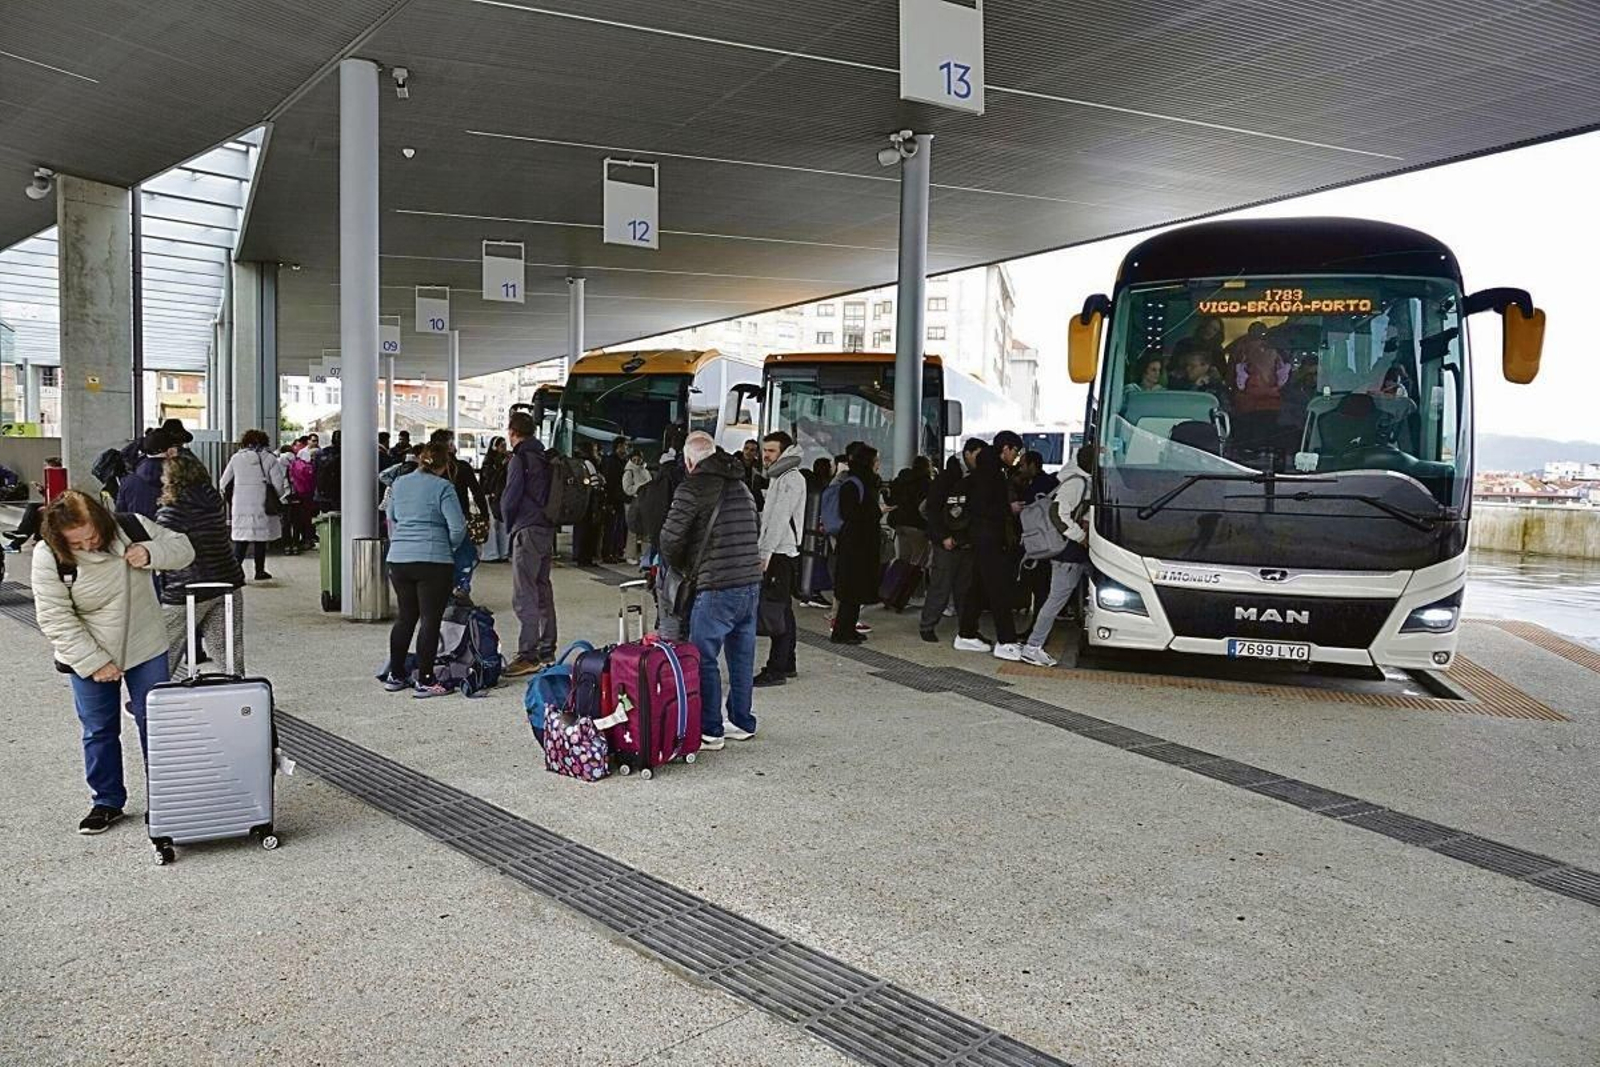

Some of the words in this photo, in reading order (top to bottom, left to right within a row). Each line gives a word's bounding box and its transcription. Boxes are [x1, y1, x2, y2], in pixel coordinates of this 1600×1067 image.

[939, 61, 971, 99] 13
[628, 220, 650, 242] 12
[502, 283, 517, 298] 11
[1264, 289, 1303, 301] 1783
[1199, 299, 1371, 313] VIGO-BRAGA-PORTO
[429, 318, 445, 331] 10
[383, 340, 398, 351] 09
[1234, 607, 1310, 624] MAN
[1237, 642, 1274, 657] 7699
[1278, 645, 1305, 659] LYG
